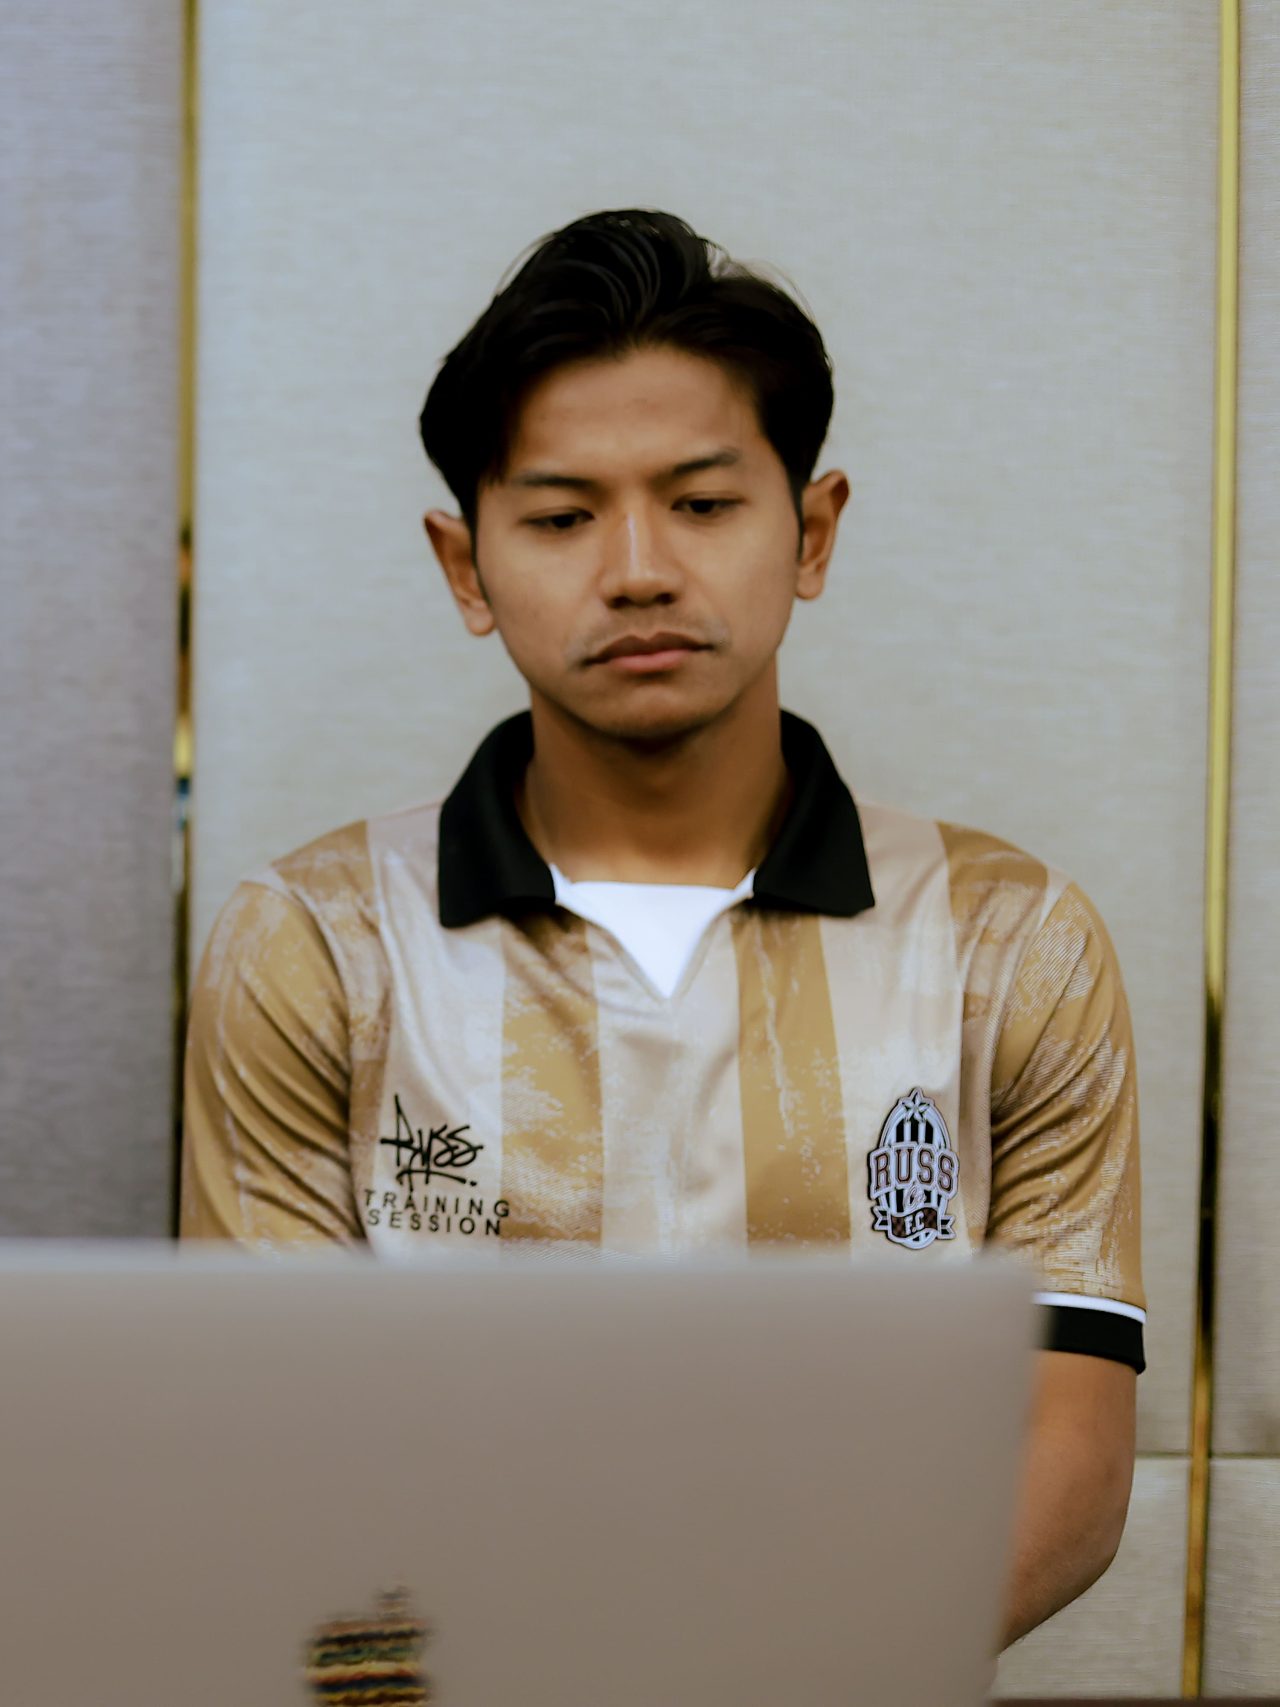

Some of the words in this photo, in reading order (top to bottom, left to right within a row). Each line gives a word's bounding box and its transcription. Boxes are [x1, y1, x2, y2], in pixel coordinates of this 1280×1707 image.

[874, 1147, 955, 1193] RUSS
[364, 1188, 510, 1218] TRAINING
[367, 1208, 501, 1236] SESSION
